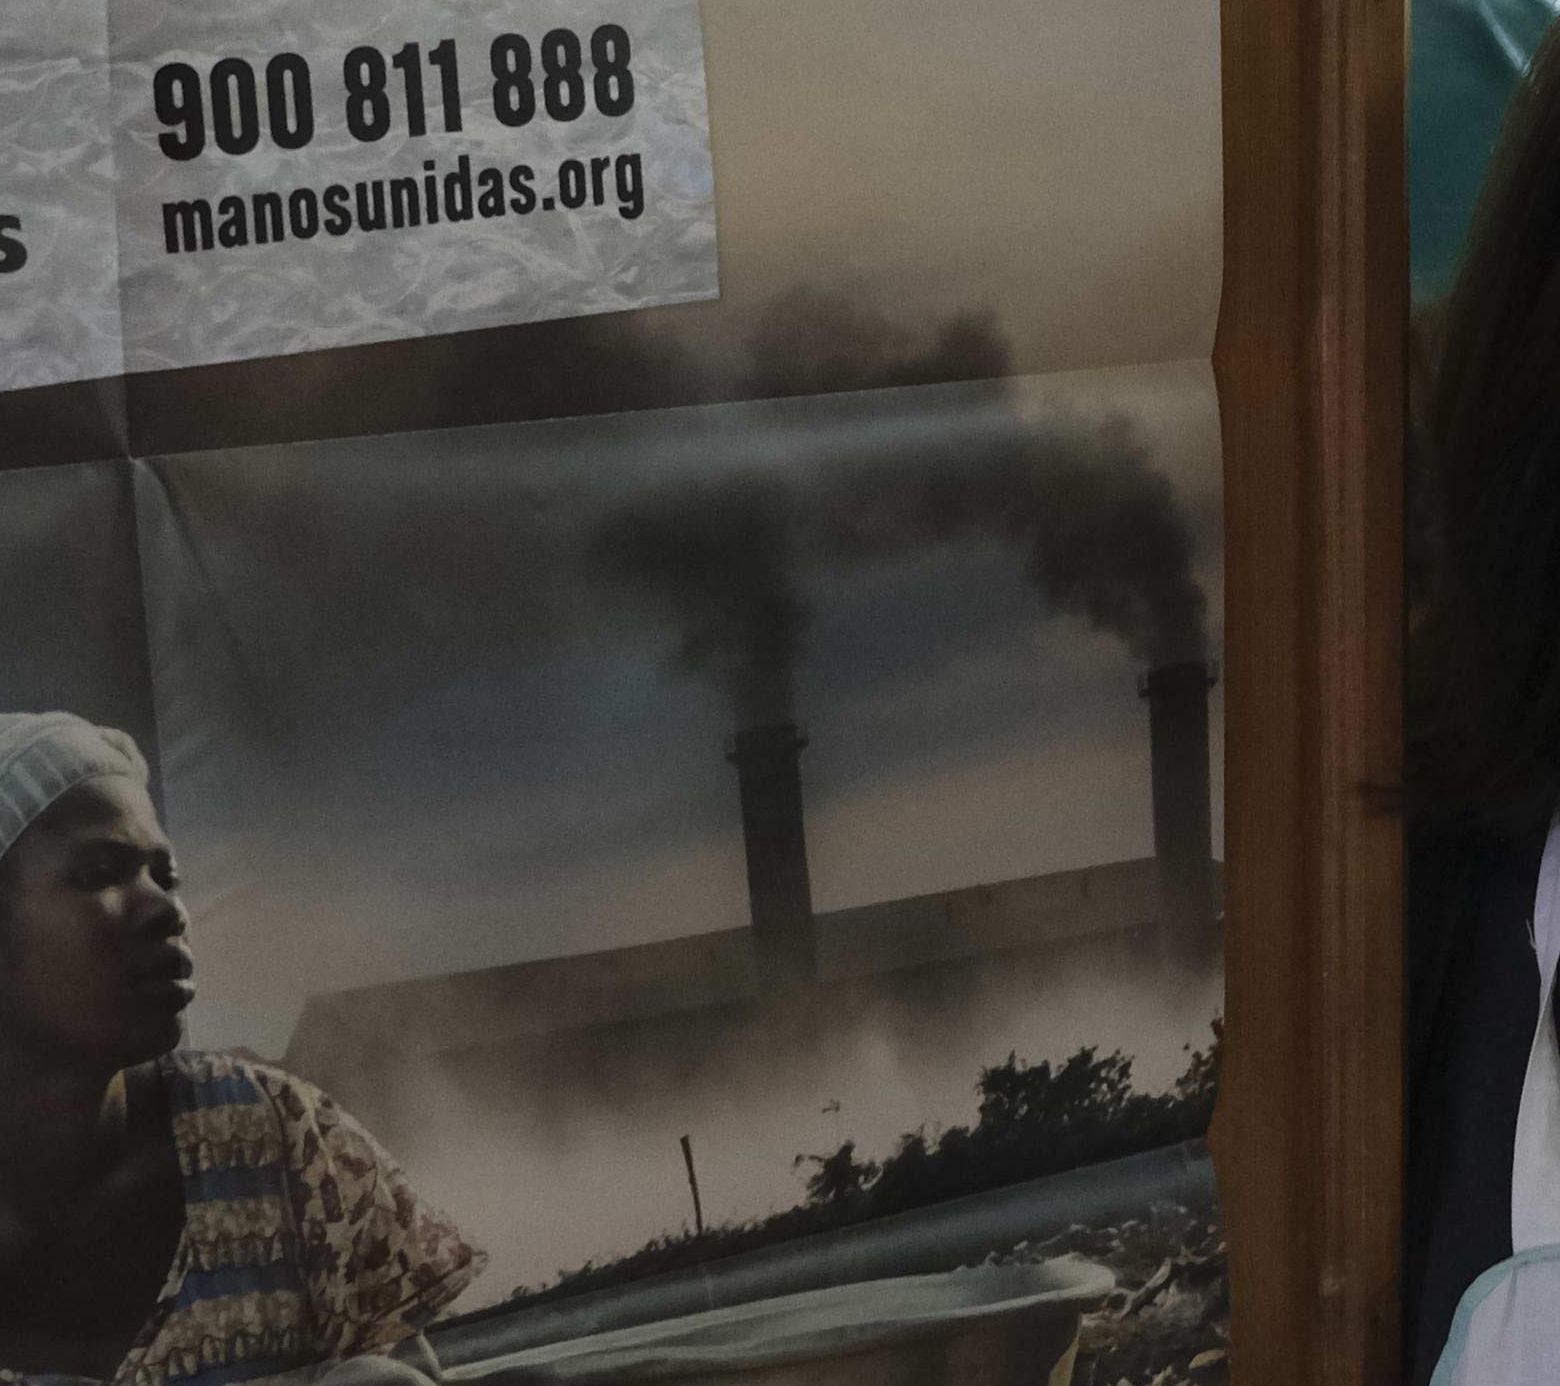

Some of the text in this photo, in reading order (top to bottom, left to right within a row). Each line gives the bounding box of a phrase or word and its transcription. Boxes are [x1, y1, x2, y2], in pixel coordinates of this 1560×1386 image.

[153, 24, 634, 162] 900 811 888
[157, 146, 644, 254] manosunidas.org
